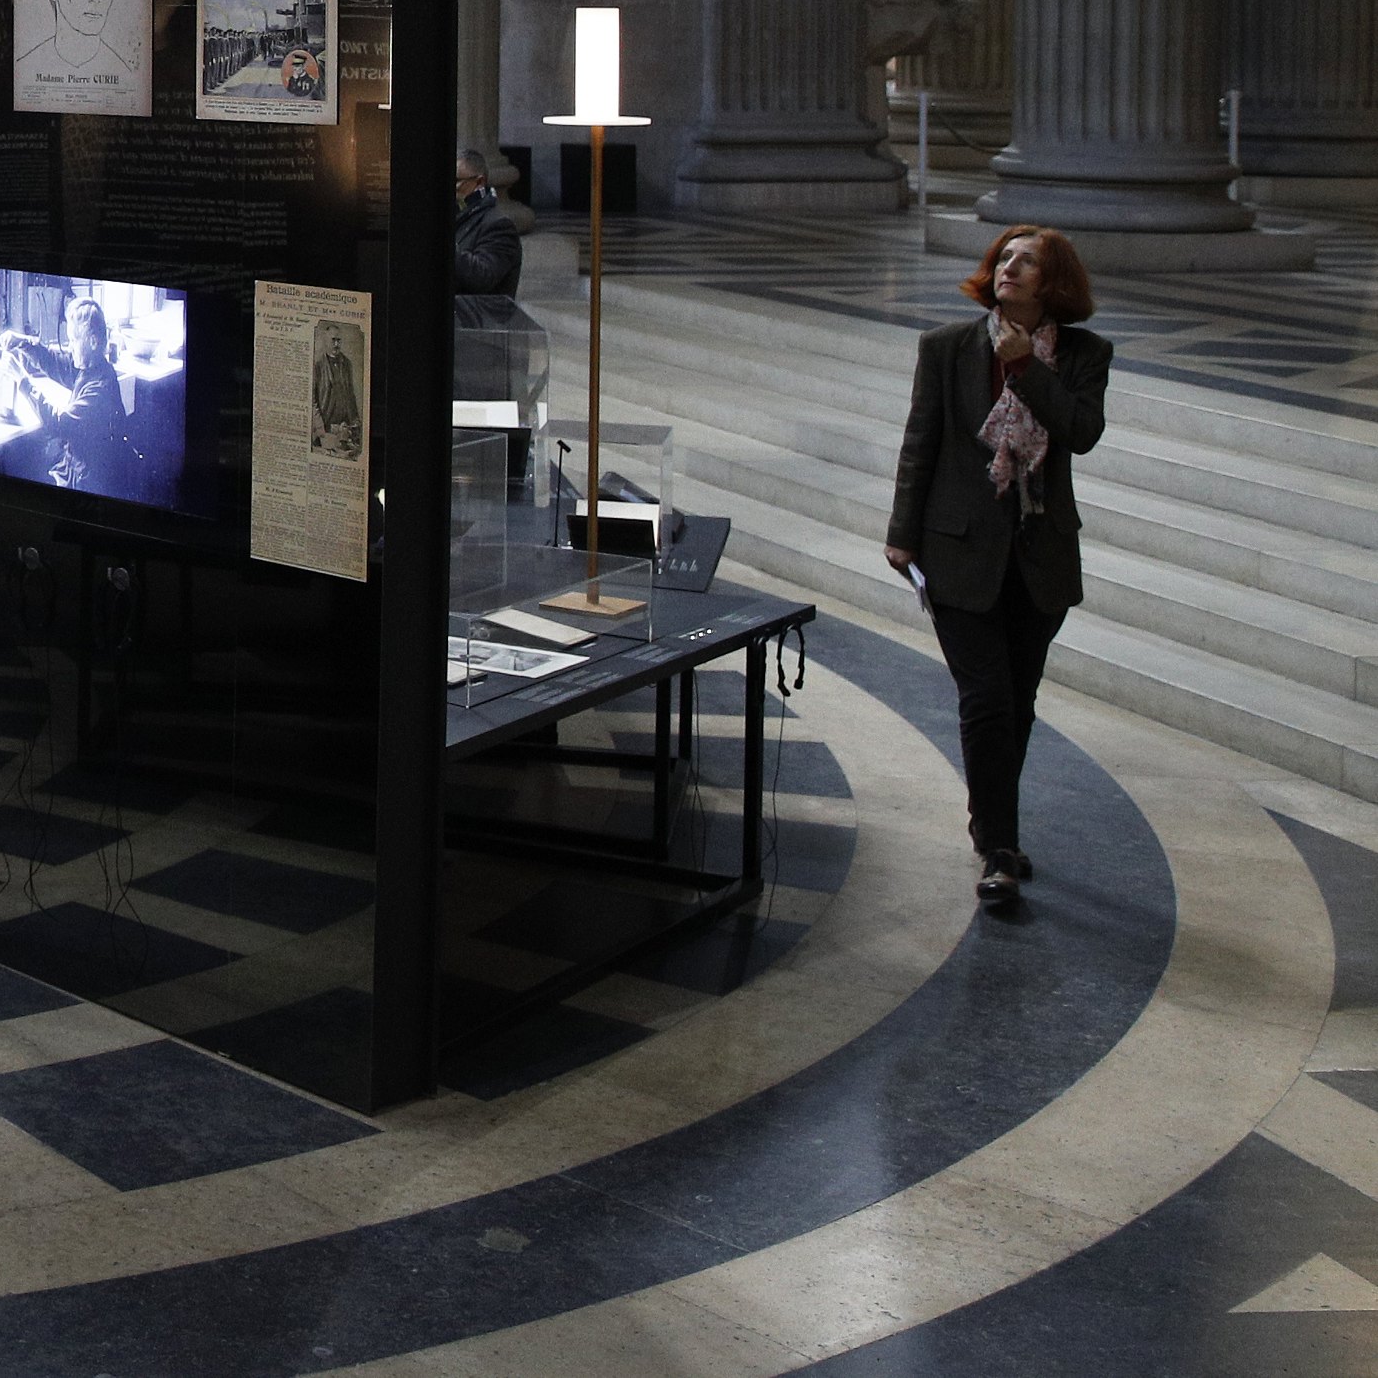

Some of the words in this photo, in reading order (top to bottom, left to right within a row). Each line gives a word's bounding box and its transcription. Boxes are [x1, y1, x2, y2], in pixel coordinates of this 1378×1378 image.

[35, 73, 64, 83] Madame
[67, 74, 90, 83] Pierre
[93, 74, 119, 84] CURIE
